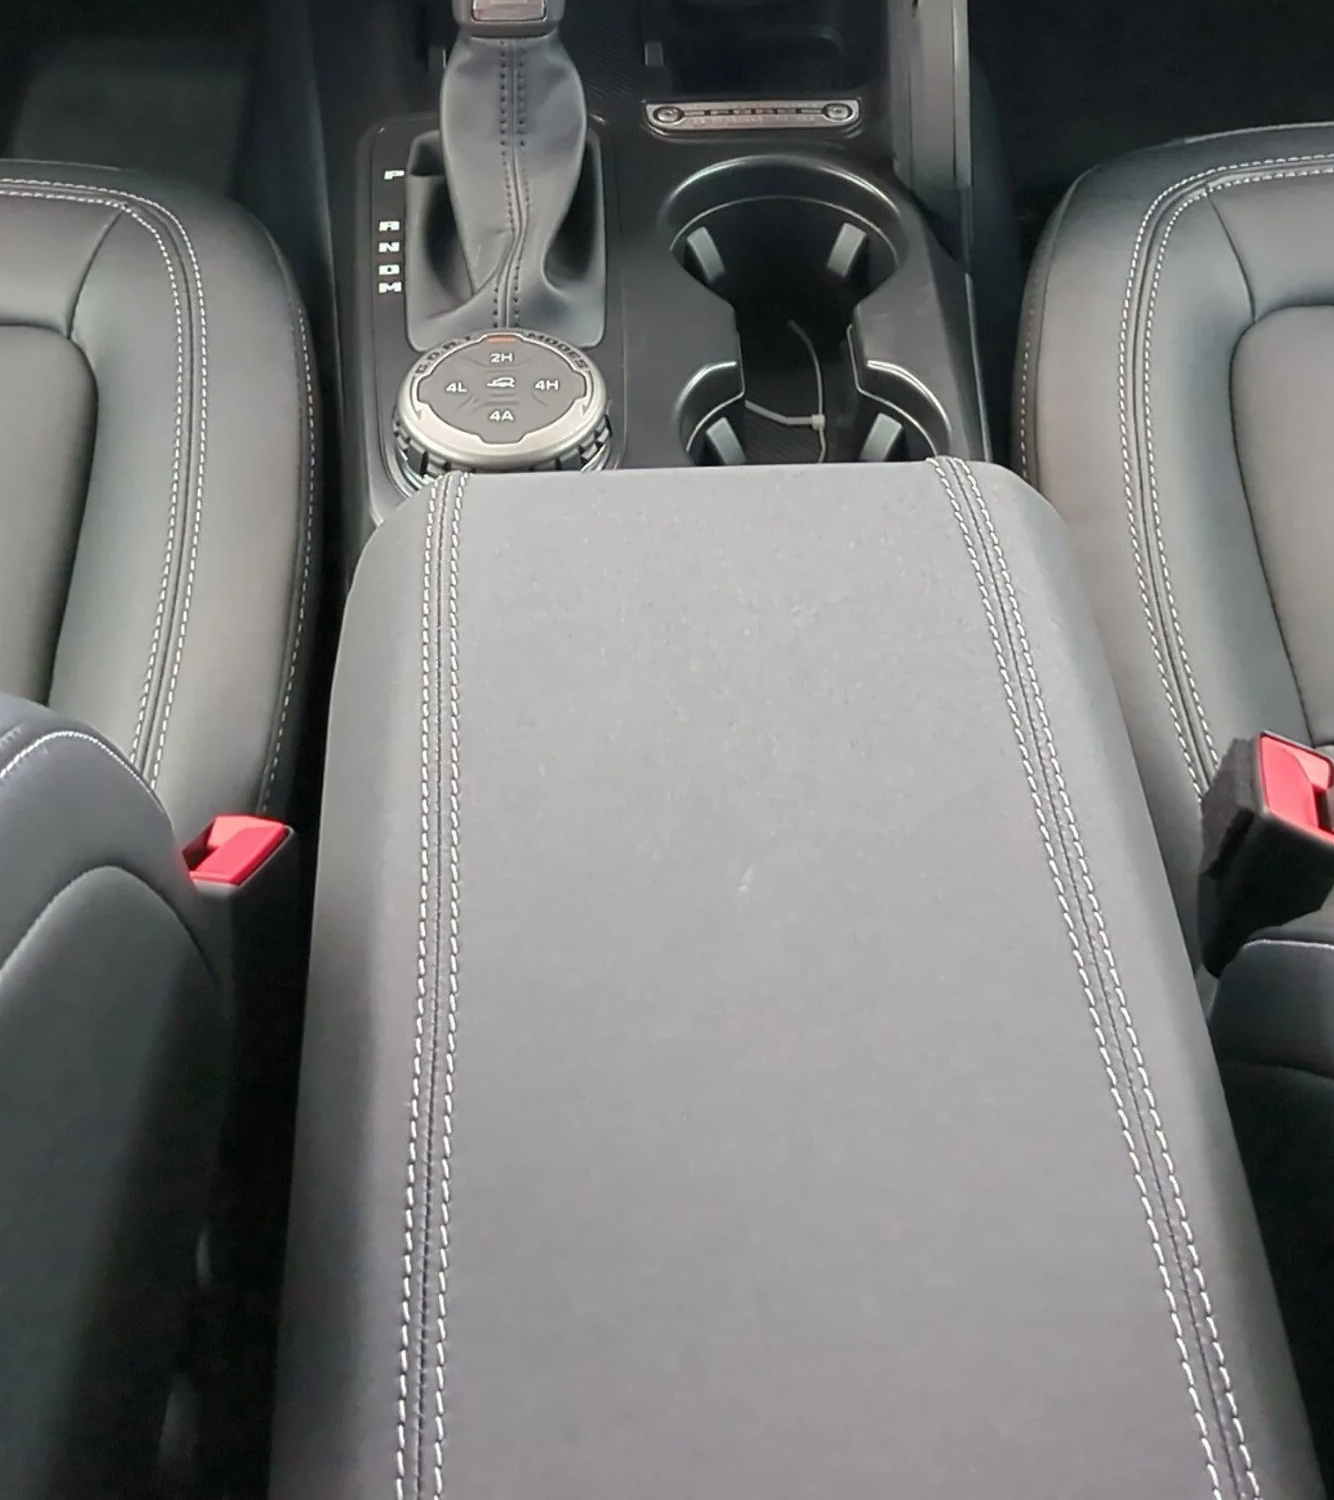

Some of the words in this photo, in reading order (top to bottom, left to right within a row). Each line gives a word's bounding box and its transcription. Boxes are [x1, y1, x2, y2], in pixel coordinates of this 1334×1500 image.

[384, 170, 405, 180] P
[379, 220, 400, 232] R
[379, 242, 400, 253] N
[379, 264, 400, 276] D
[378, 281, 403, 294] M
[528, 331, 589, 370] MODES
[490, 353, 514, 364] 2H
[445, 382, 467, 393] 4L
[535, 379, 560, 391] 4H
[488, 409, 515, 422] 4A
